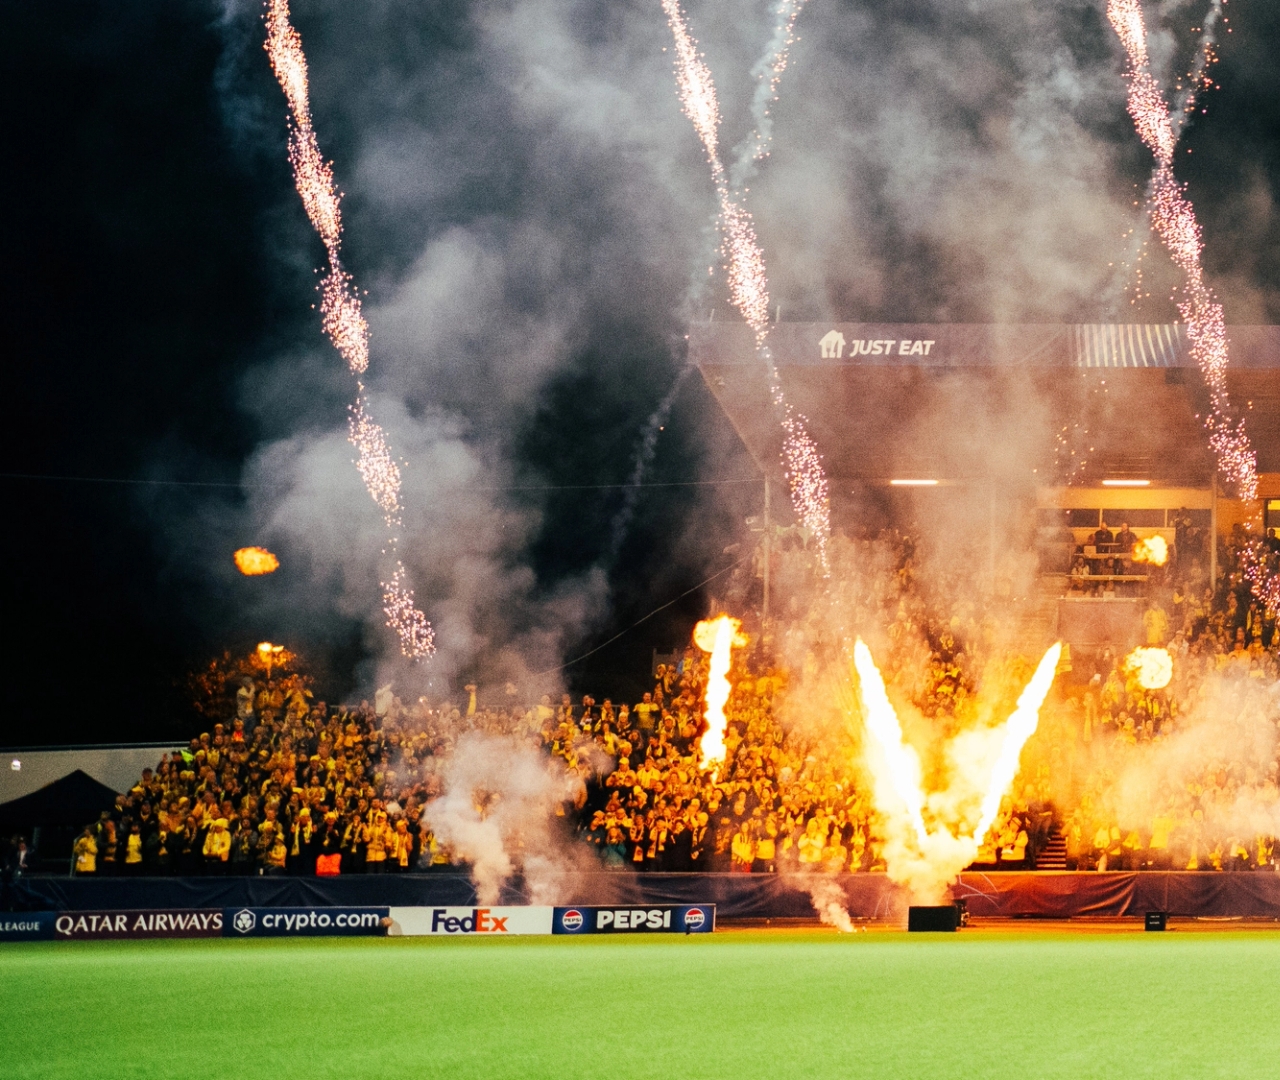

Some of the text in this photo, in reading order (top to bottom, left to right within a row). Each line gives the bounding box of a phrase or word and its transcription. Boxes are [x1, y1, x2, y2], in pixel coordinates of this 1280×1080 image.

[850, 340, 935, 357] JUST EAT
[0, 921, 40, 931] LEAGUE
[55, 913, 223, 935] QATAR AIRWAYS
[262, 911, 379, 930] crypto.com
[431, 909, 508, 932] FedEx
[597, 910, 671, 929] PEPSI
